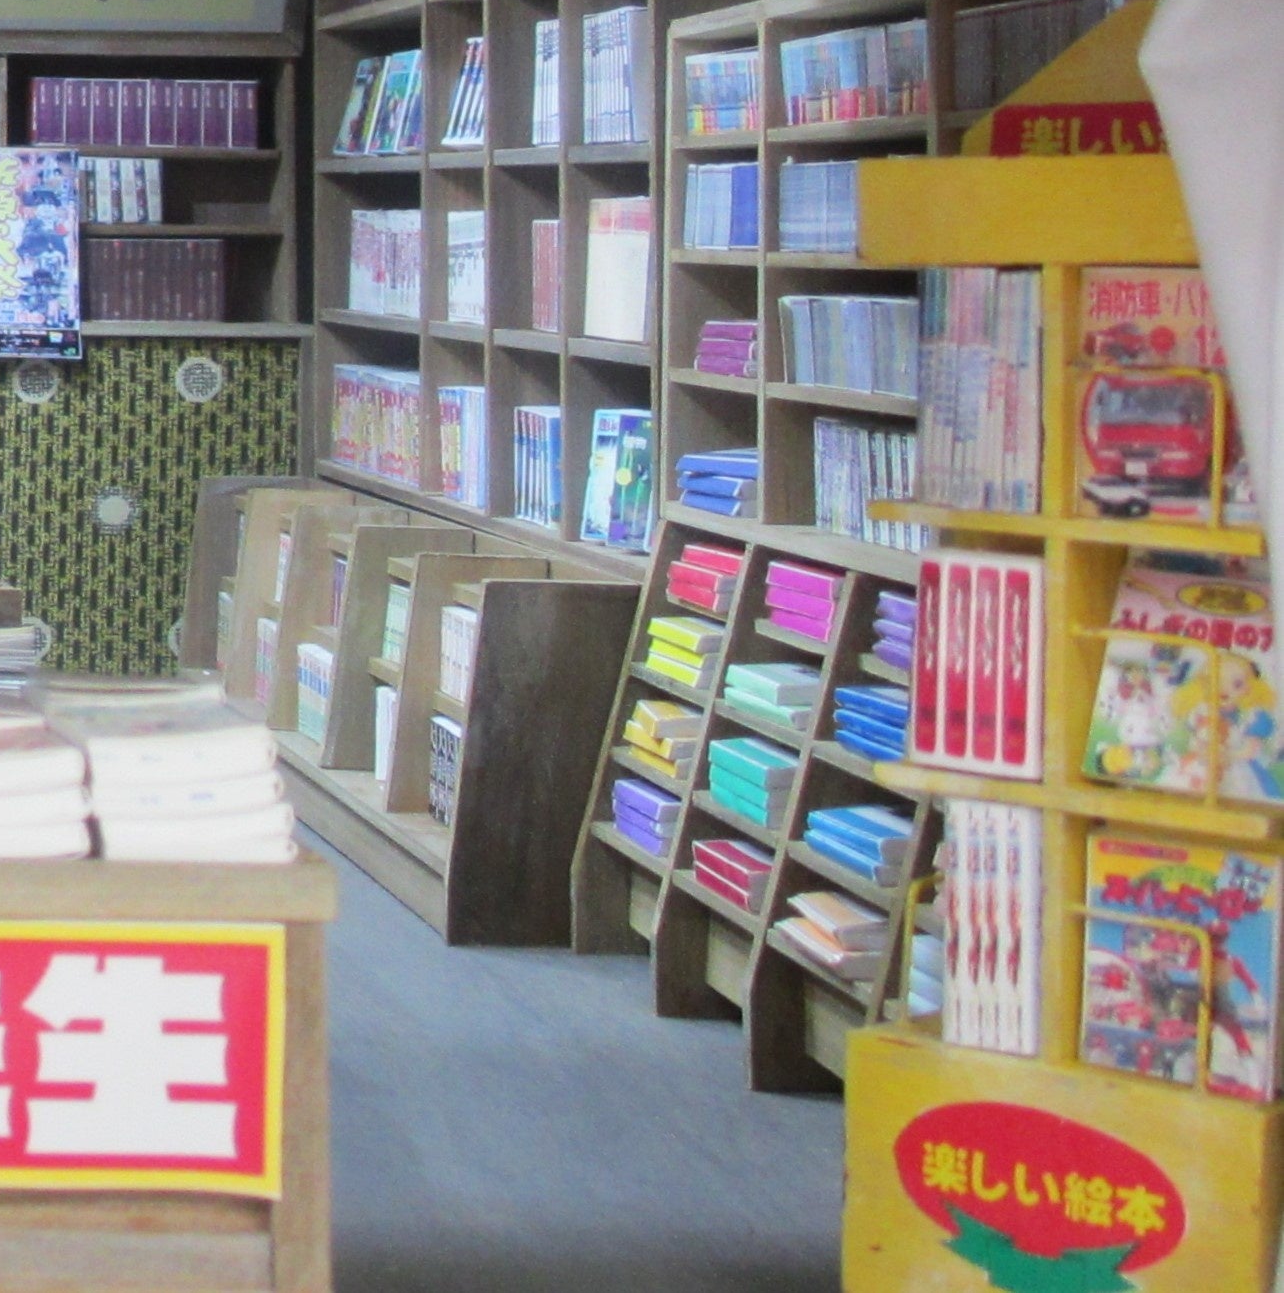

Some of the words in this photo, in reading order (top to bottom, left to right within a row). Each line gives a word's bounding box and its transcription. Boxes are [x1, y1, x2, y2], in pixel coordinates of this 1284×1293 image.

[922, 1141, 1166, 1235] 楽しい絵本
